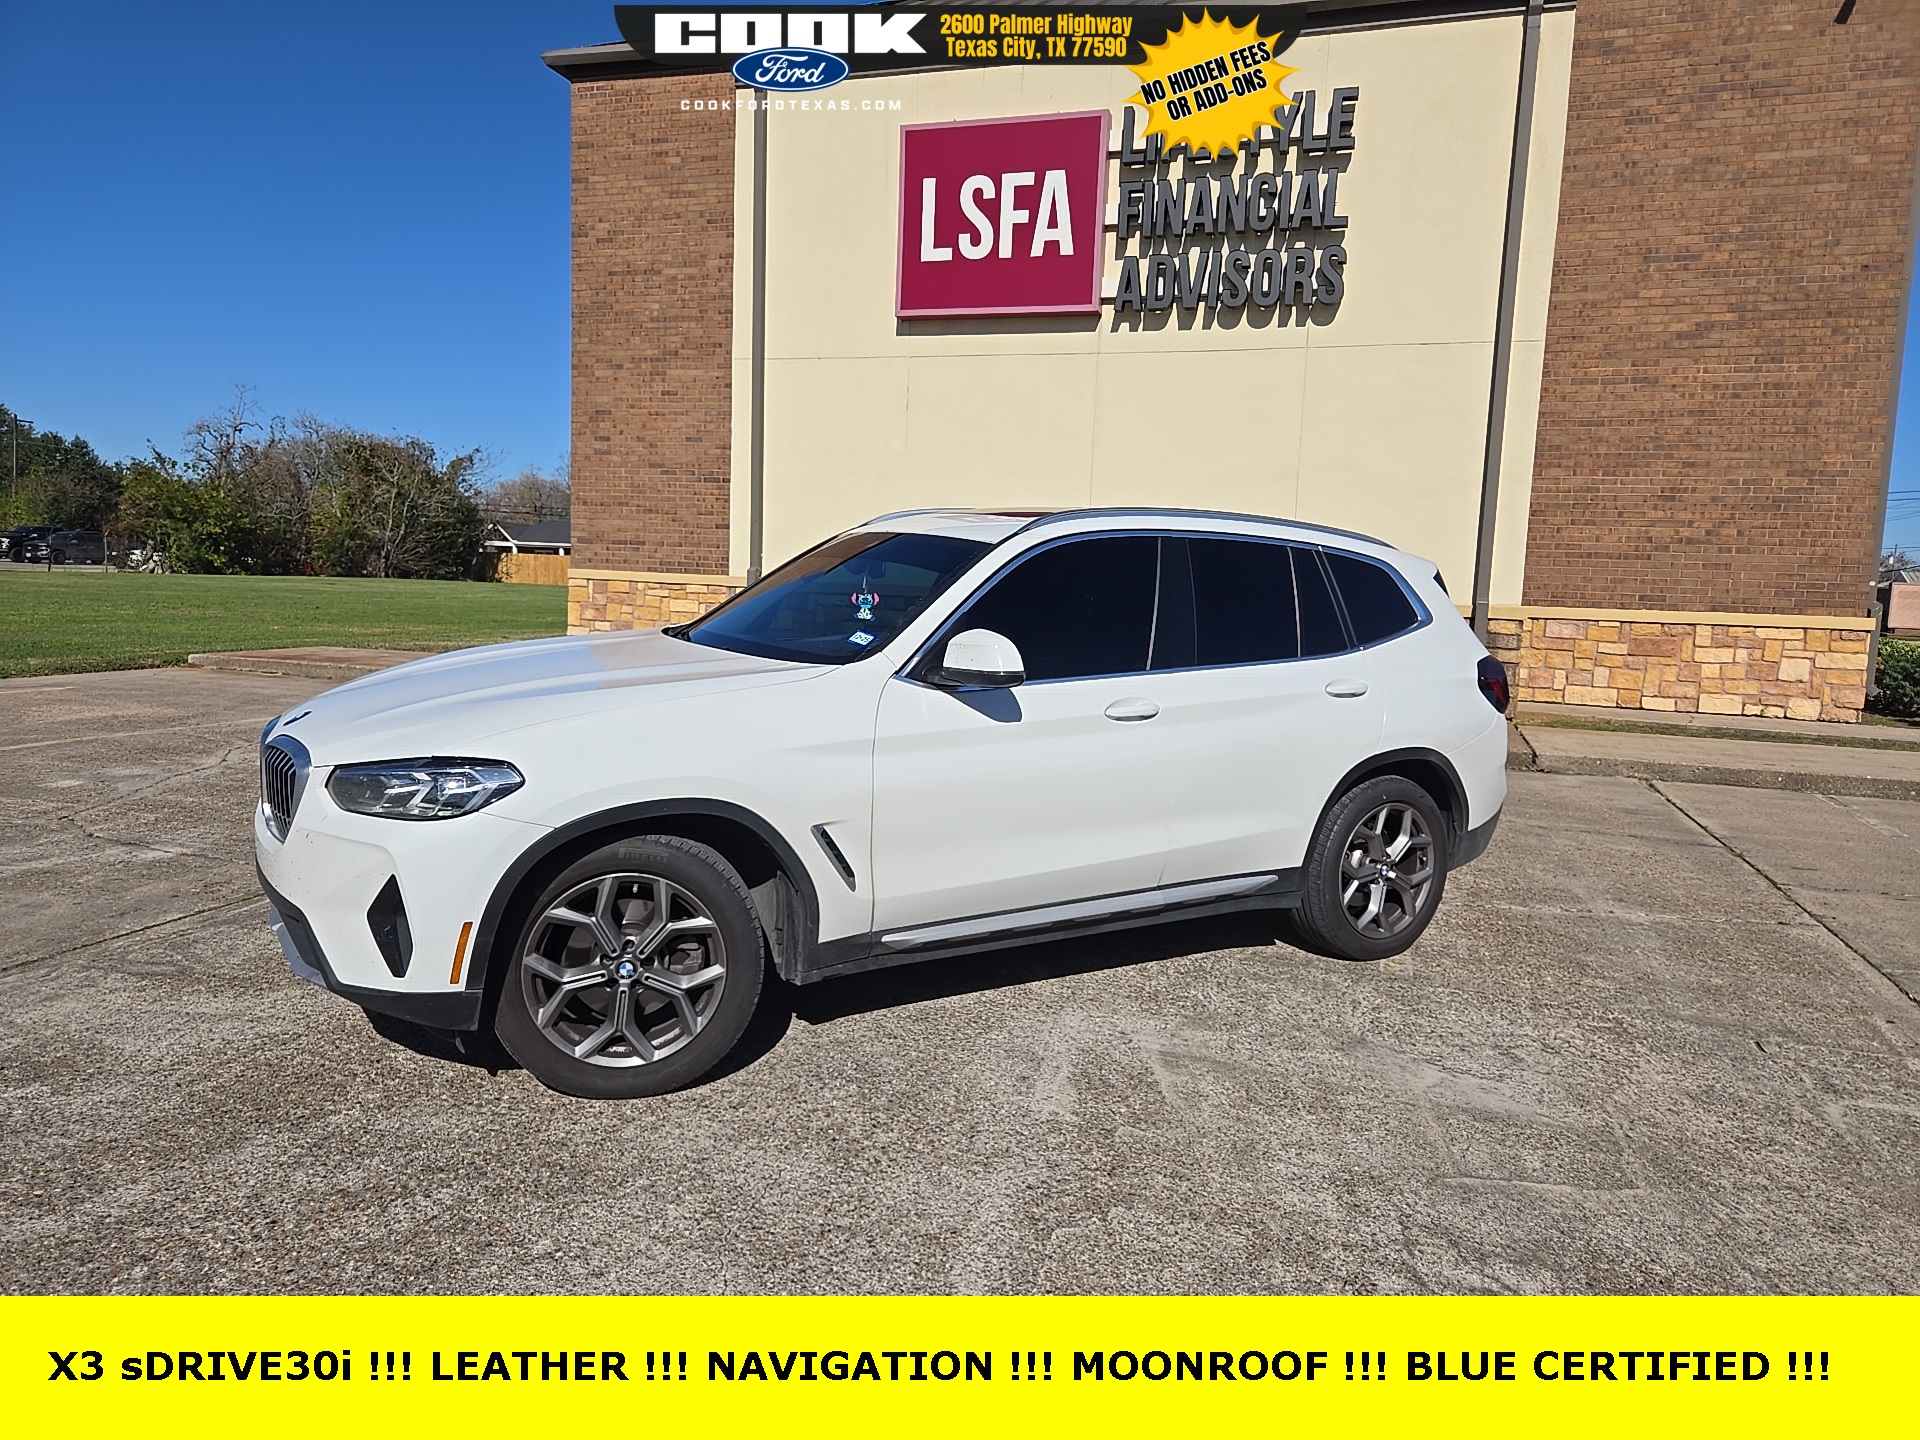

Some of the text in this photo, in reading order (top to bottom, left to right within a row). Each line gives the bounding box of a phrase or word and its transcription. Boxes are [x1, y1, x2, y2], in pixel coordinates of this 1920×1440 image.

[1121, 86, 1359, 167] LIYLE
[920, 169, 1074, 262] LSFA
[1118, 167, 1348, 240] FINANCIAL
[1114, 245, 1347, 312] ADVISORS
